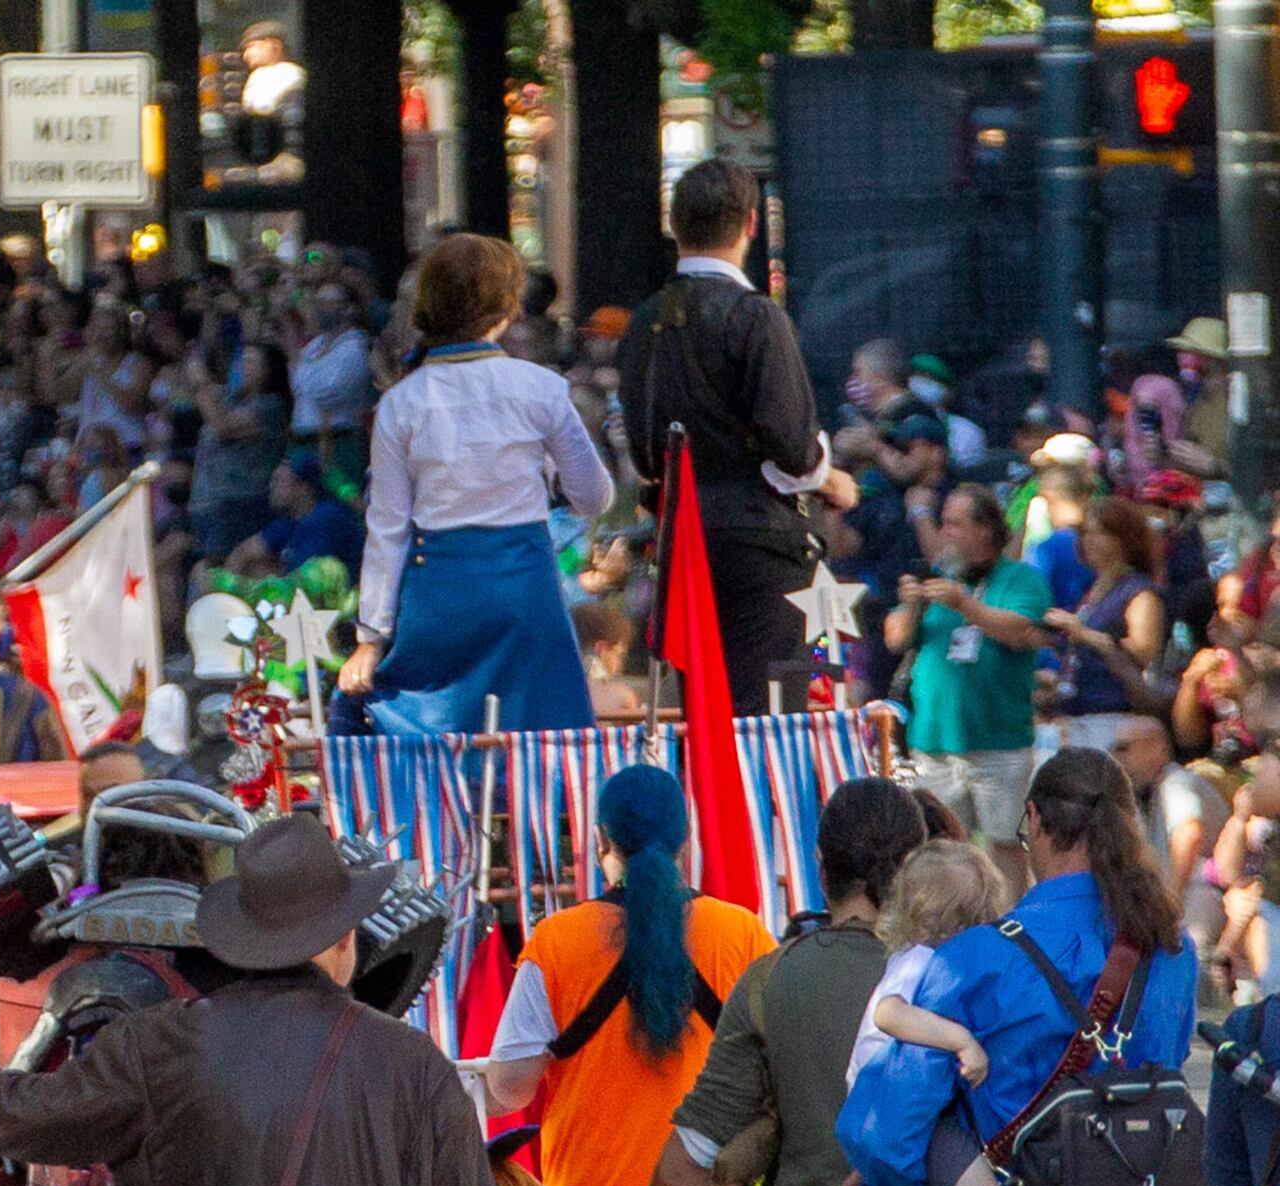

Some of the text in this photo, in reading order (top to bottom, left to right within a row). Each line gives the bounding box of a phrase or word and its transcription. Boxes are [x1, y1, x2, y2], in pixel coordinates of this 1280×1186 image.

[9, 73, 134, 97] RIGHT LANE
[32, 115, 109, 142] MUST
[9, 160, 139, 183] TURN RIGHT
